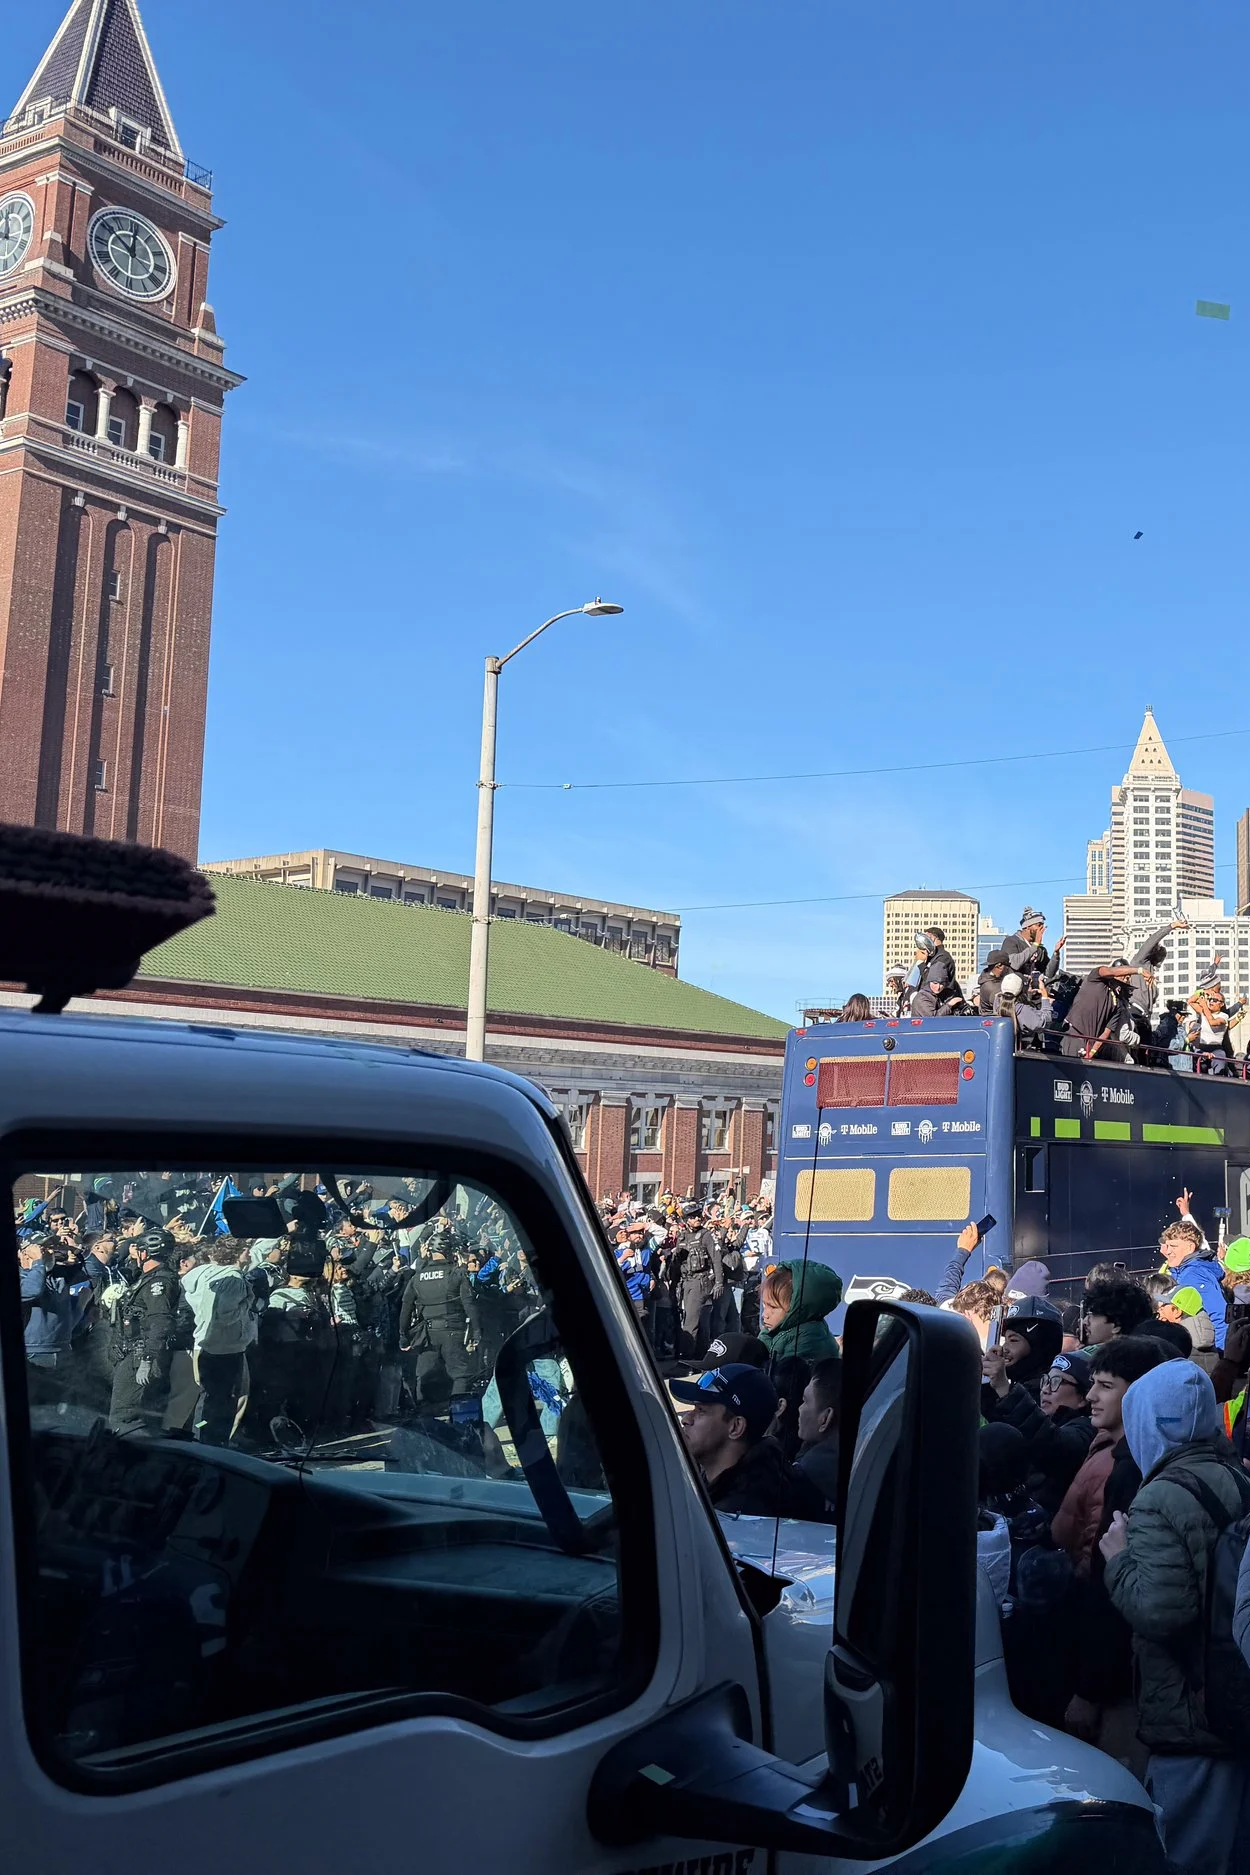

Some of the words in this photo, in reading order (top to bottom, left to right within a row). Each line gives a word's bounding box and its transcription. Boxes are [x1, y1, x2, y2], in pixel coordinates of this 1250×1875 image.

[1055, 1091, 1071, 1099] LIGHT
[1109, 1088, 1135, 1104] Mobile
[849, 1124, 878, 1135] Mobile
[951, 1121, 981, 1132] Mobile
[420, 1270, 444, 1281] POLICE
